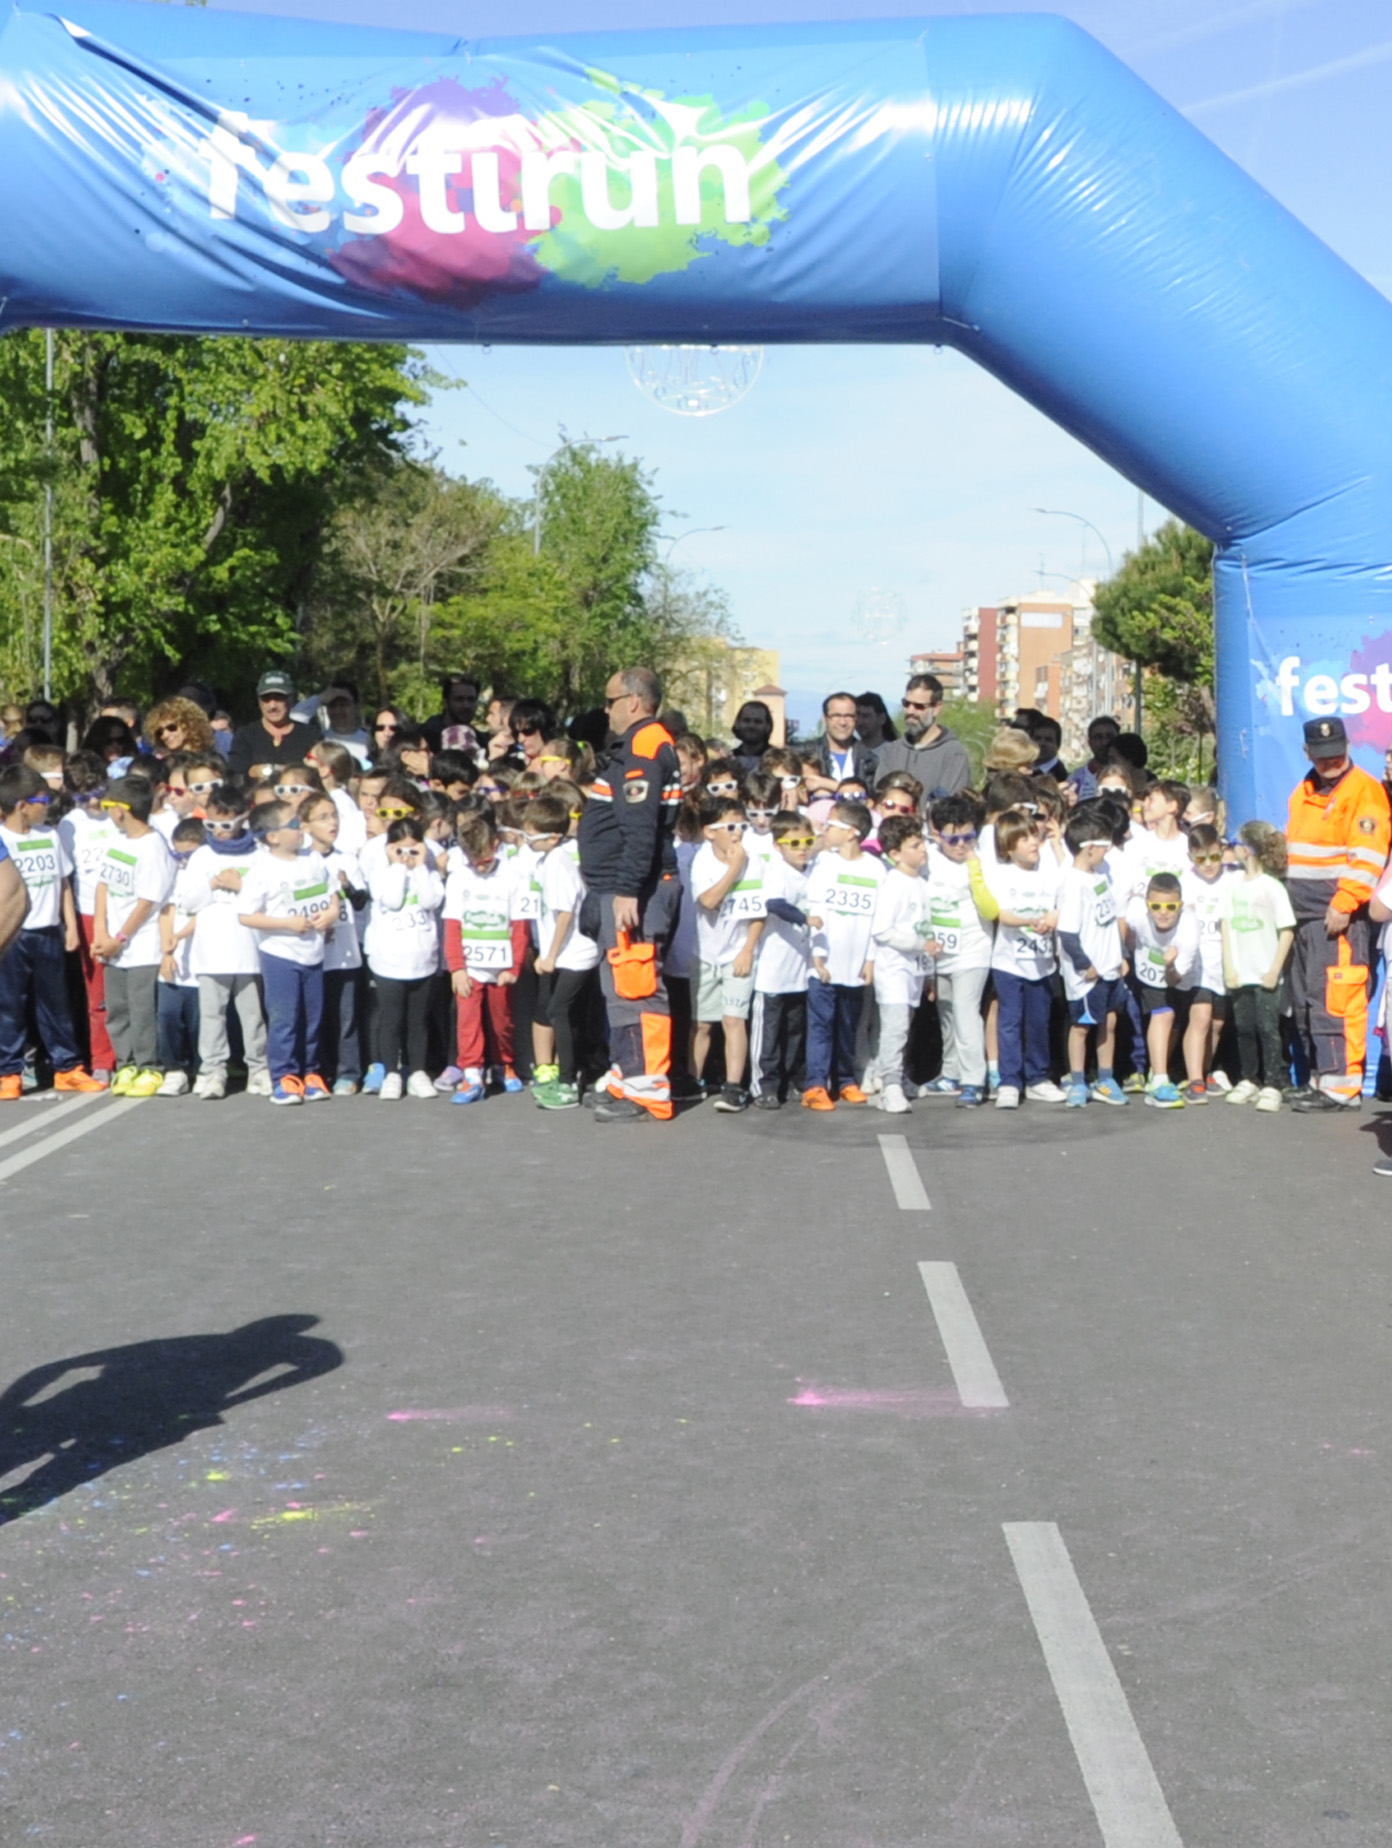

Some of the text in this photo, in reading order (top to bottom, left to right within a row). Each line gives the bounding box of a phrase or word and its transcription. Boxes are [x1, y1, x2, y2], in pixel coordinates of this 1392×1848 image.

[15, 854, 56, 873] 2203
[100, 862, 130, 887] 2730
[825, 888, 872, 910] 2335
[464, 945, 507, 962] 2571
